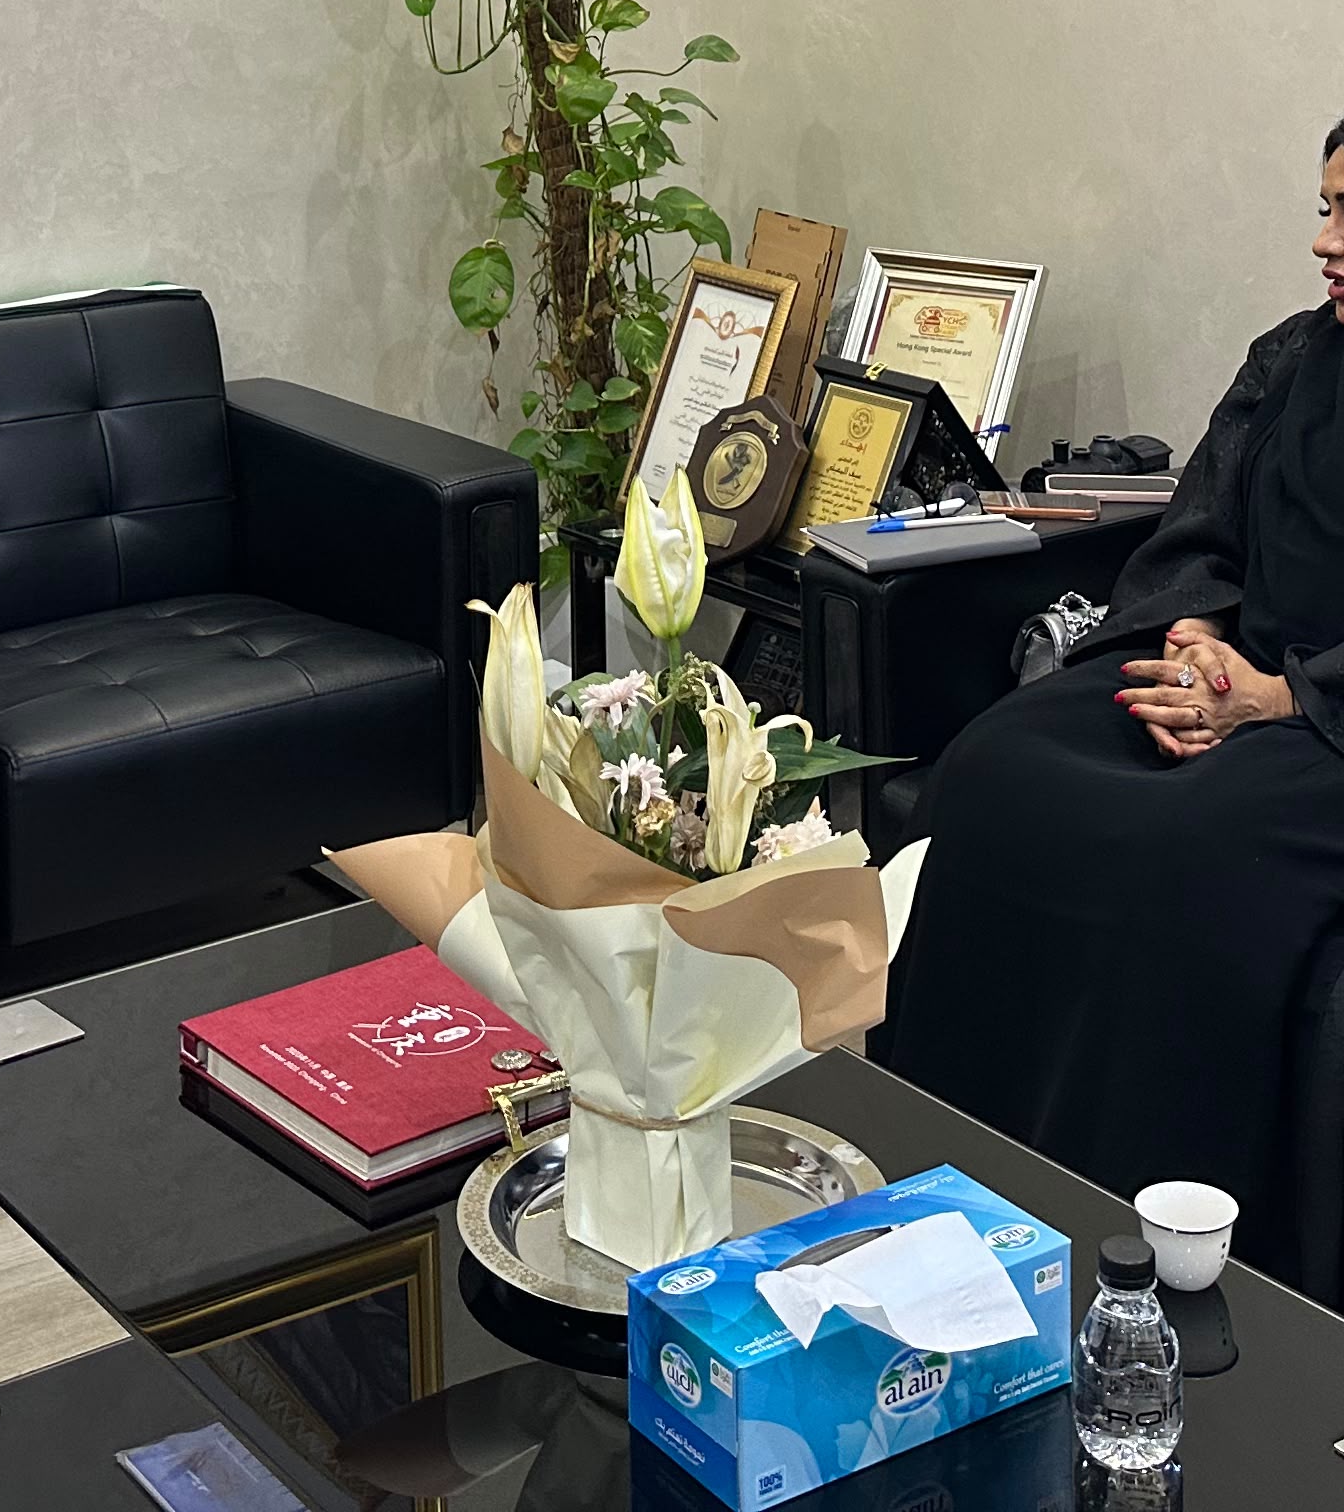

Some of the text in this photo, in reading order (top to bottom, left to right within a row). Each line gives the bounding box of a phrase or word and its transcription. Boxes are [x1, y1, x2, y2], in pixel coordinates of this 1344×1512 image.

[896, 341, 973, 358] Hong Kong Special Award
[670, 1272, 712, 1292] al ain
[885, 1368, 944, 1406] al ain
[993, 1372, 1027, 1395] Comfort
[1027, 1365, 1044, 1381] that
